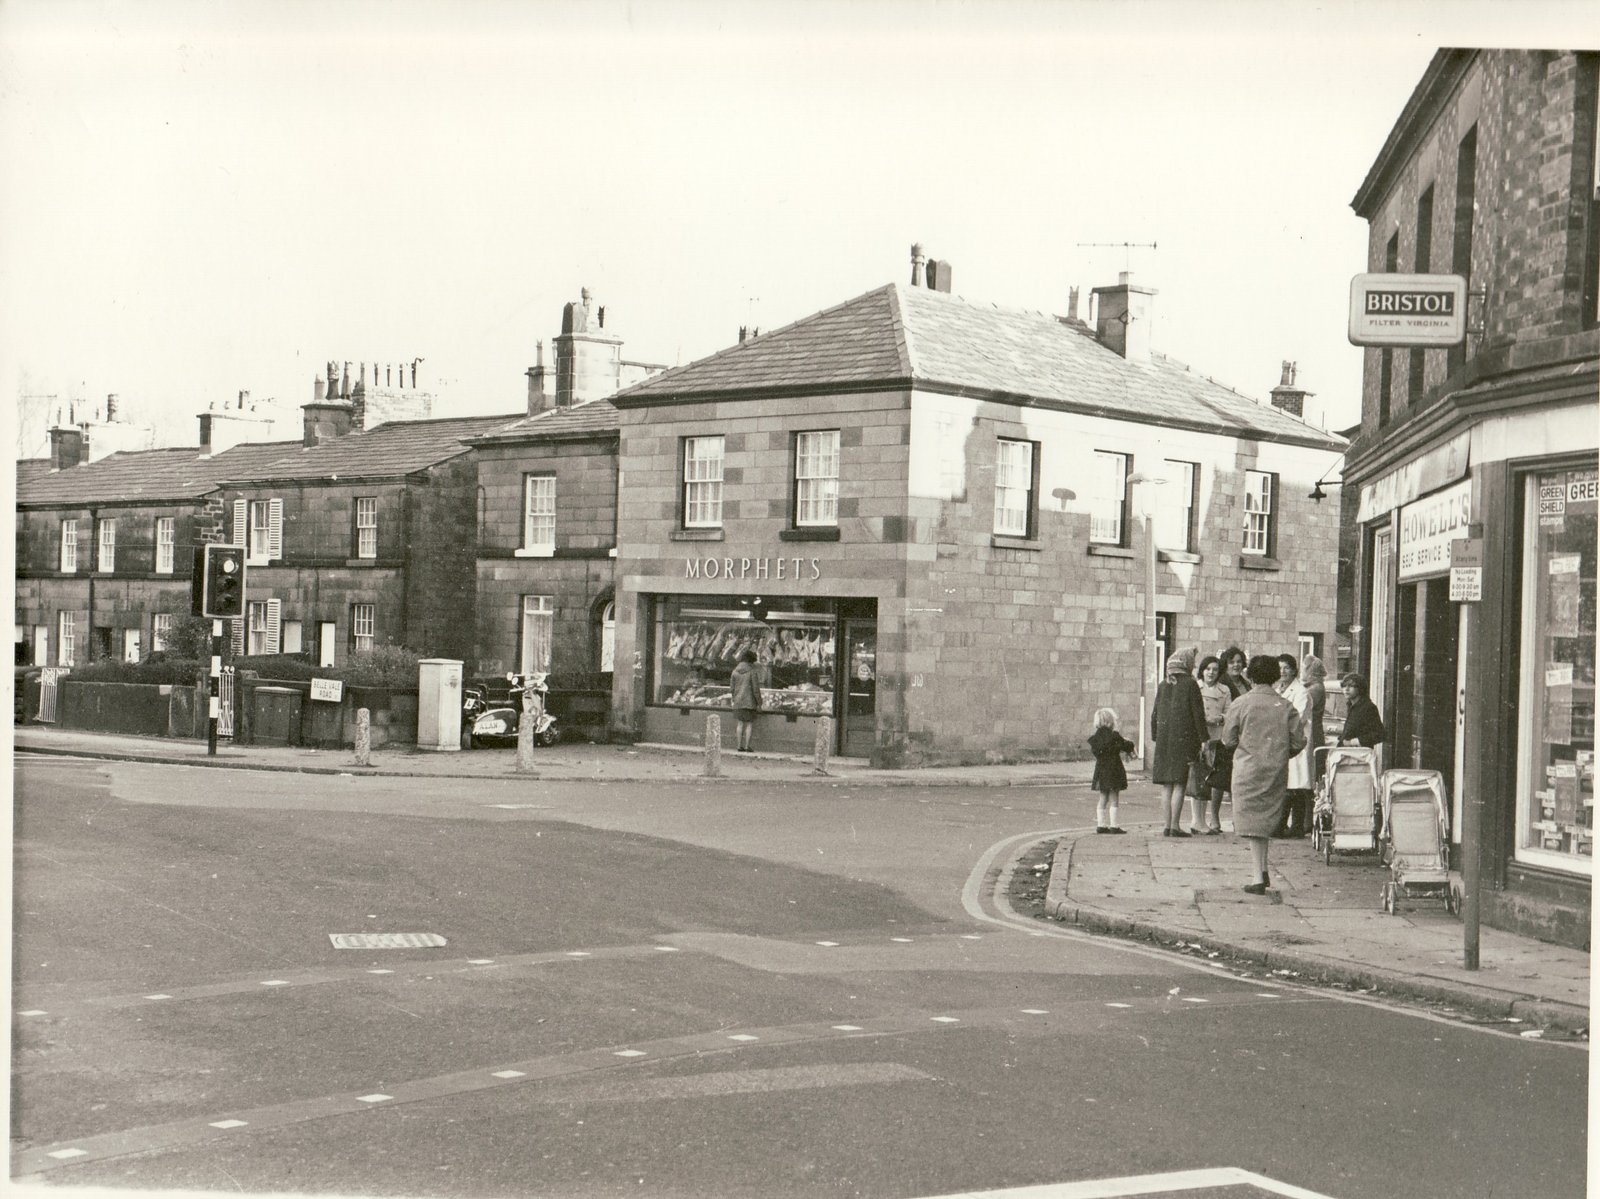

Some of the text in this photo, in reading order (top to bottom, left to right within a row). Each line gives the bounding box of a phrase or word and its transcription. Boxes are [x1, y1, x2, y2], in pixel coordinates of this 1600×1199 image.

[1367, 293, 1452, 312] BRISTOL
[1369, 319, 1450, 327] FILTER VIRGINIA
[1540, 487, 1564, 499] GREEN
[1540, 501, 1564, 513] SHIELD
[1403, 493, 1469, 544] HOWELL'S
[685, 557, 820, 580] MORPHETS
[313, 680, 340, 691] BELLE VALE
[319, 690, 332, 699] ROAD
